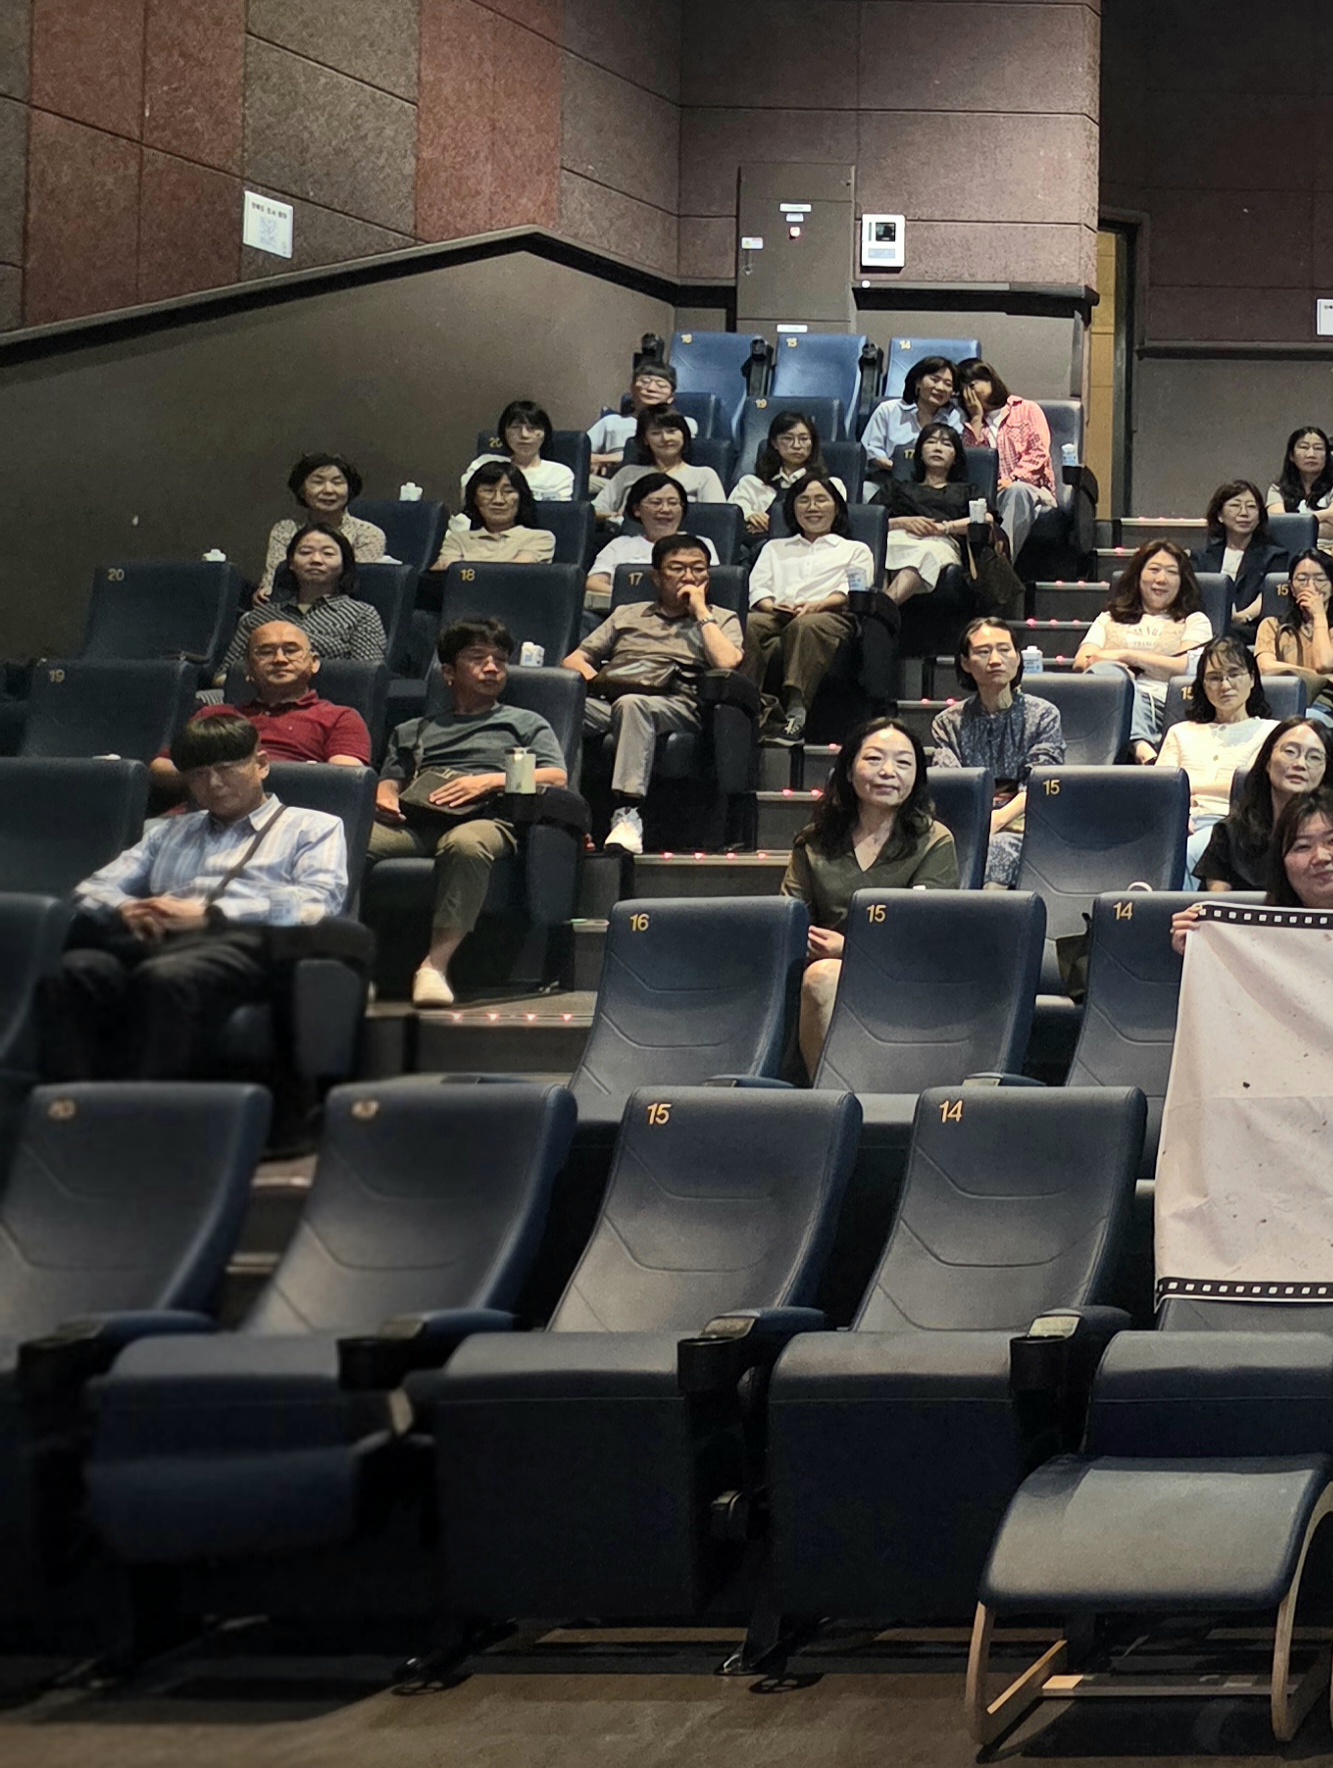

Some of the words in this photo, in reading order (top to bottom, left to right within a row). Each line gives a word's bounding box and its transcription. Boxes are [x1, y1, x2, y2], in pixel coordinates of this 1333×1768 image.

[489, 438, 501, 447] 20
[904, 450, 914, 459] 17
[108, 569, 124, 581] 20
[461, 569, 475, 581] 18
[629, 572, 643, 584] 17
[1276, 584, 1289, 595] 15
[49, 670, 64, 682] 19
[1043, 780, 1059, 794] 15
[867, 904, 887, 922] 15
[1113, 902, 1133, 920] 14
[630, 914, 649, 931] 16
[648, 1103, 671, 1124] 15
[940, 1100, 964, 1122] 14
